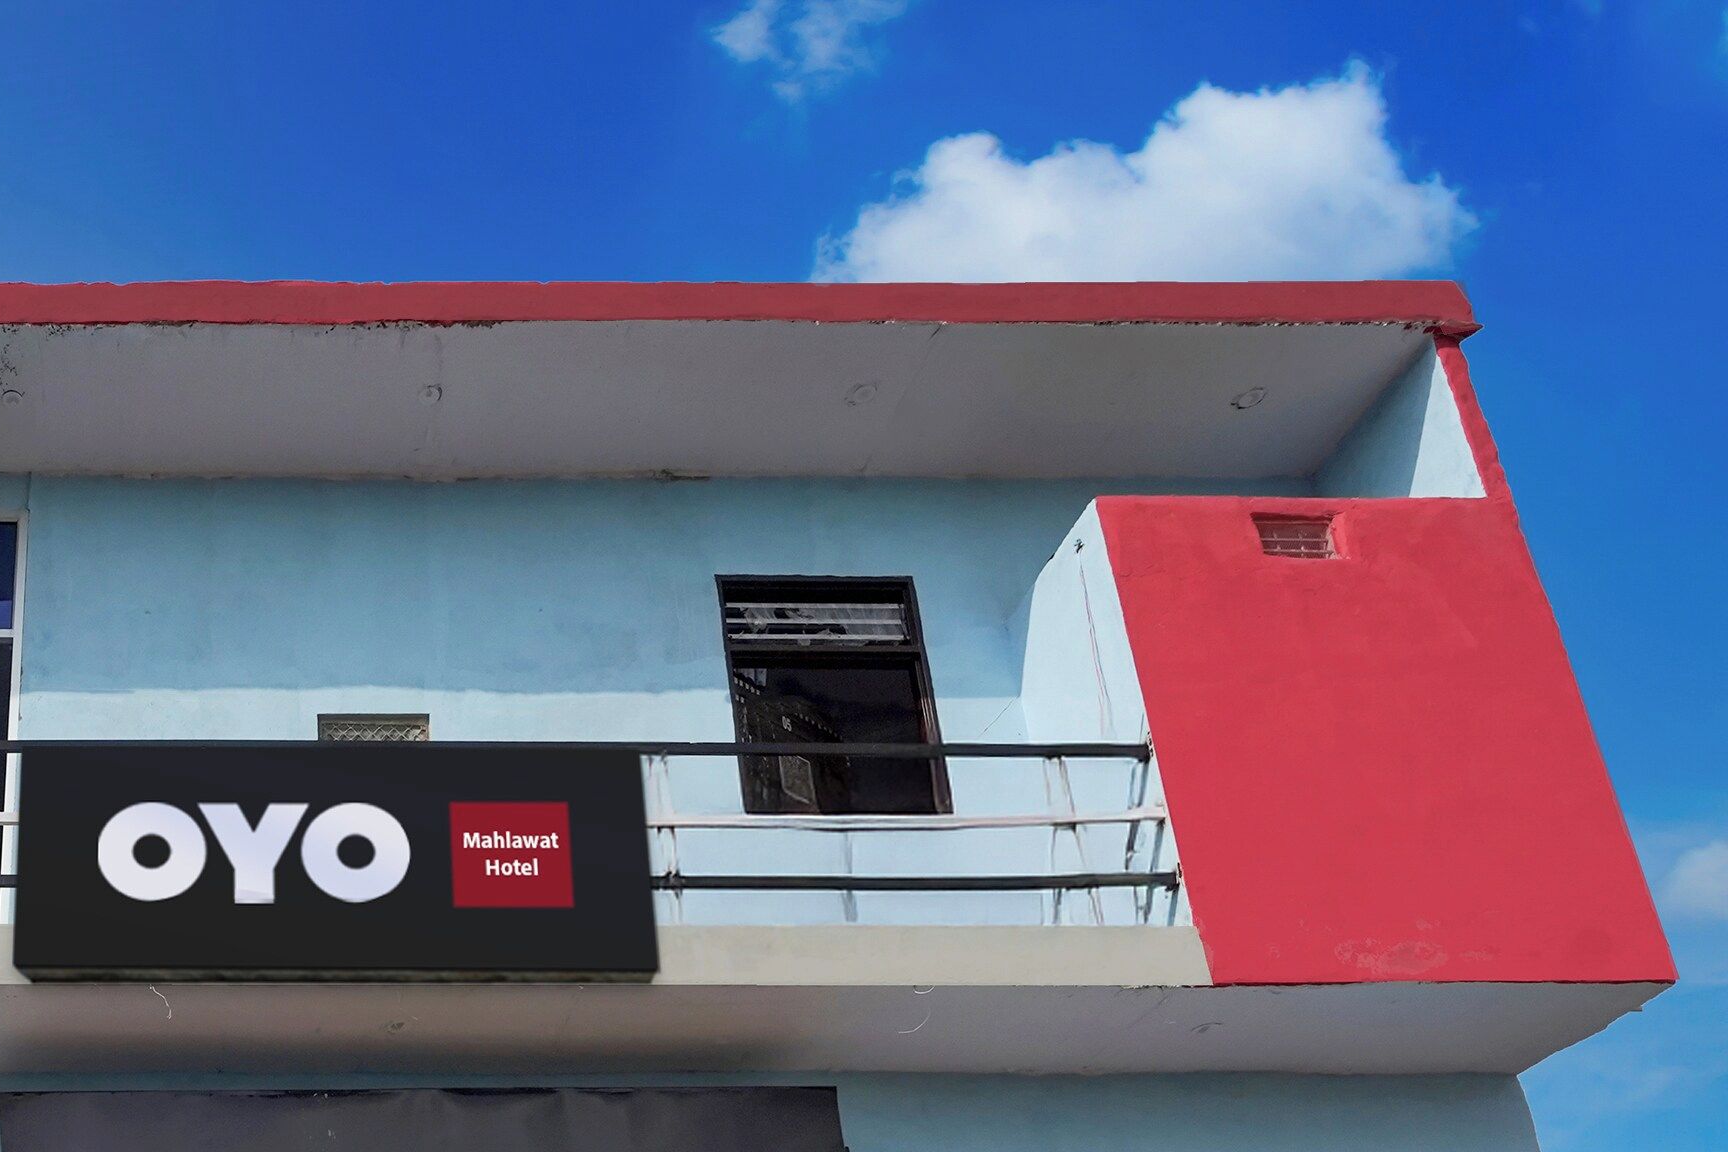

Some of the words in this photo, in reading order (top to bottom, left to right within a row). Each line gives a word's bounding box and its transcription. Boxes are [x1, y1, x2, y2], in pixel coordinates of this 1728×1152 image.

[463, 830, 560, 849] Mahlawat
[97, 802, 411, 904] OYO
[485, 857, 539, 876] Hotel
